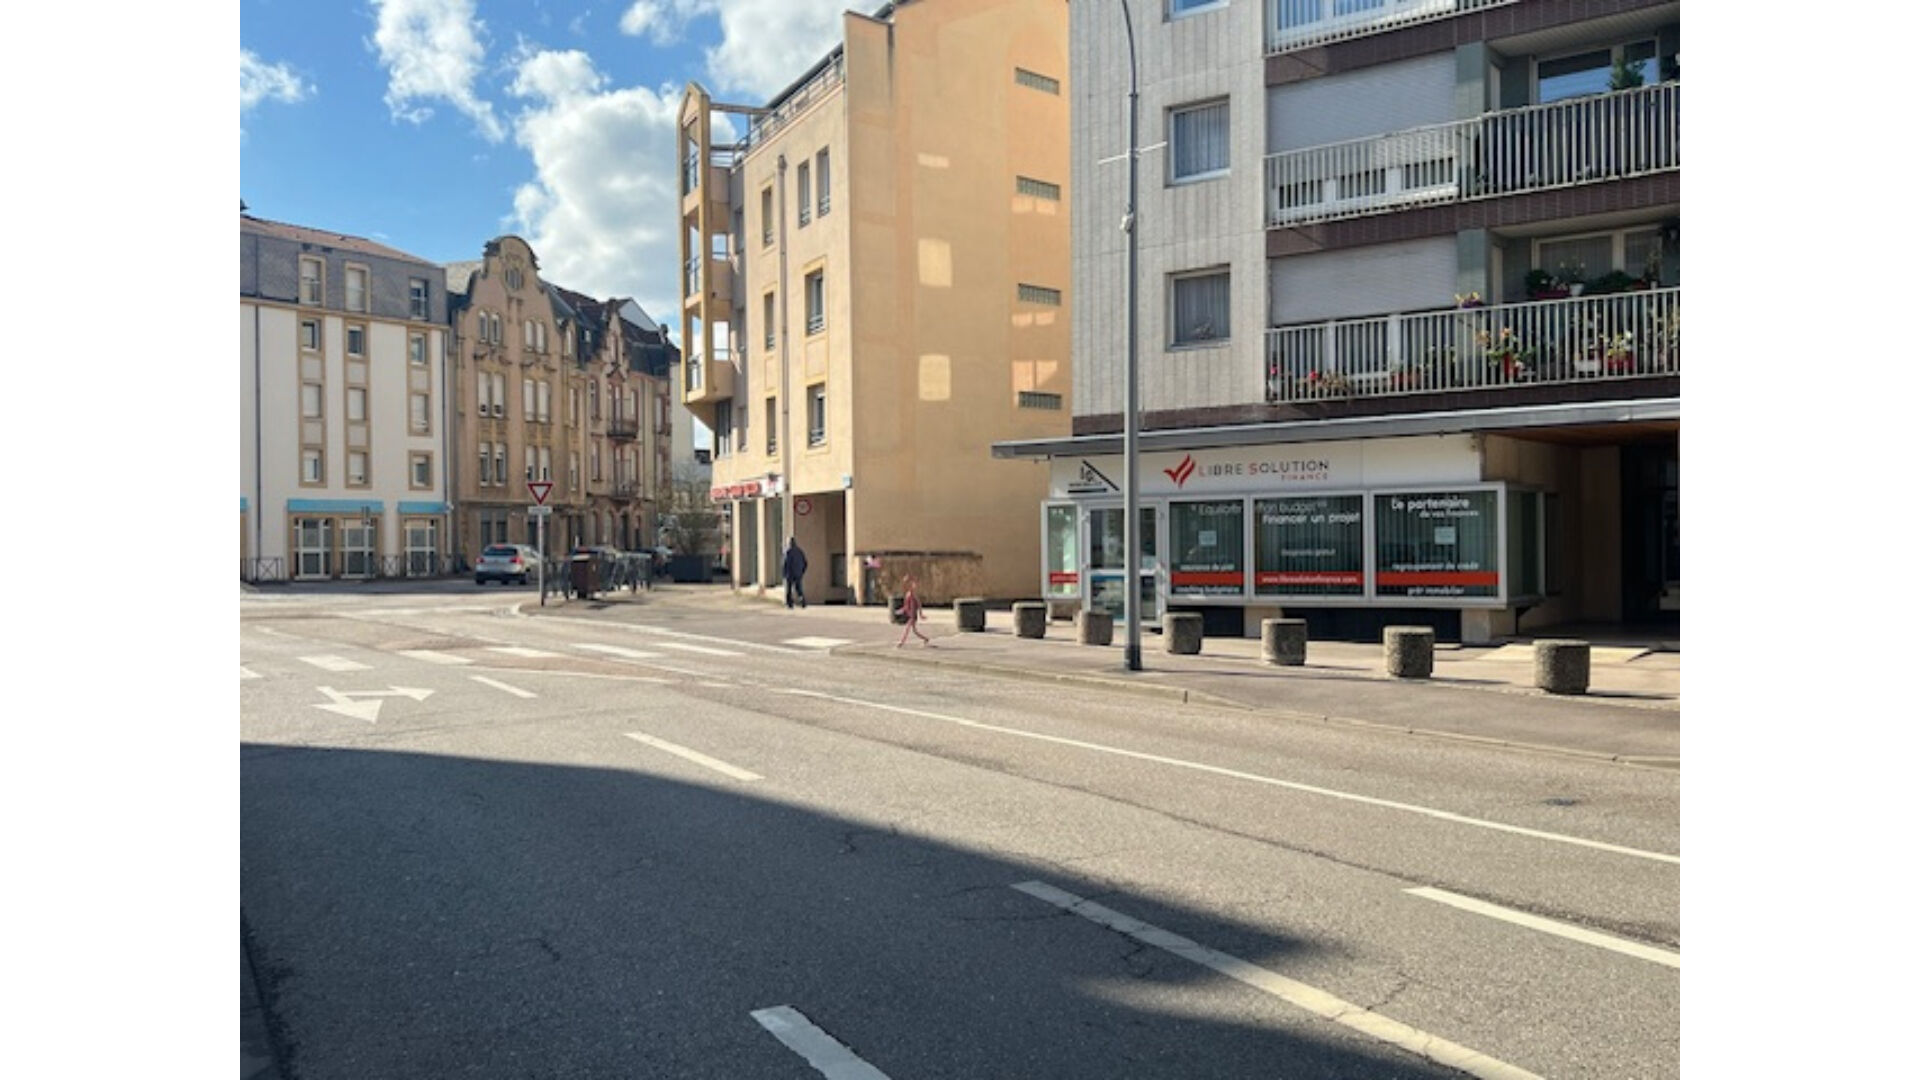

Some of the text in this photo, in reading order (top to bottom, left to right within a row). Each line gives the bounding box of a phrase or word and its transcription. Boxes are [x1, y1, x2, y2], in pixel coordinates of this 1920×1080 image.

[1199, 460, 1329, 478] LIBRE SOLUTION
[1281, 473, 1328, 481] FINANCE
[1407, 495, 1470, 513] partenaire
[1263, 512, 1360, 525] financer un projet
